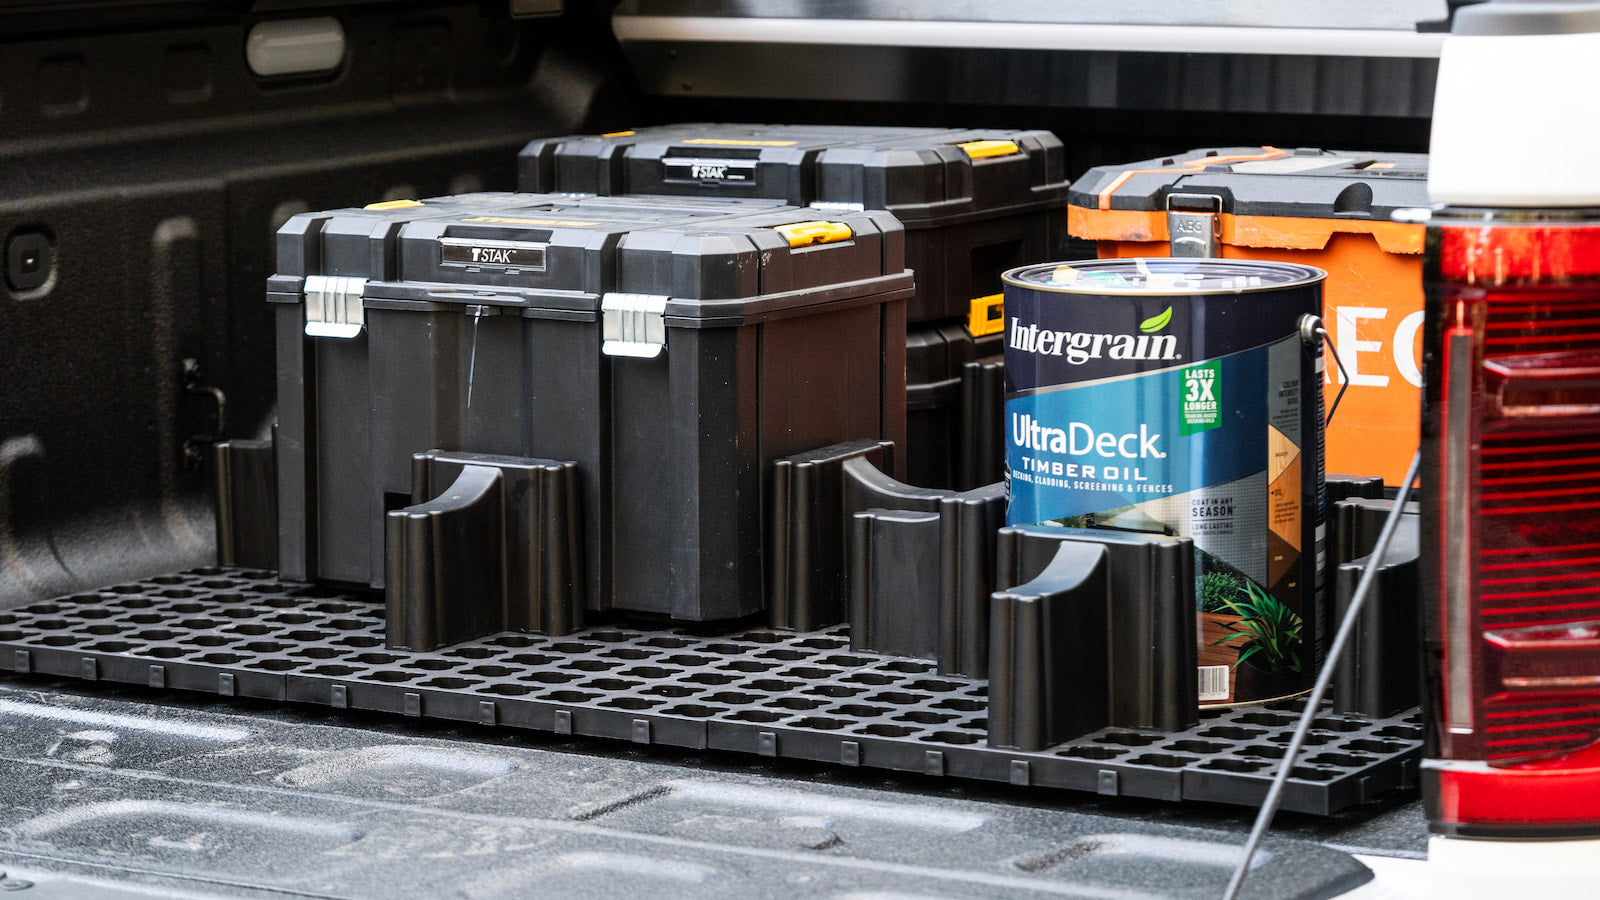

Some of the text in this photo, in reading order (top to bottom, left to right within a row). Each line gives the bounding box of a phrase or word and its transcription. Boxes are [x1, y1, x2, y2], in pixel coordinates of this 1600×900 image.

[1177, 219, 1202, 233] AEG
[1185, 369, 1215, 379] LASTS
[1185, 379, 1215, 401] 3X
[1184, 401, 1217, 411] LONGER
[1022, 456, 1148, 481] TIMBER OIL
[1034, 474, 1071, 490] CLADDING,
[1073, 481, 1124, 493] SCREENING
[1127, 484, 1133, 492] &
[1137, 484, 1173, 493] FENCES
